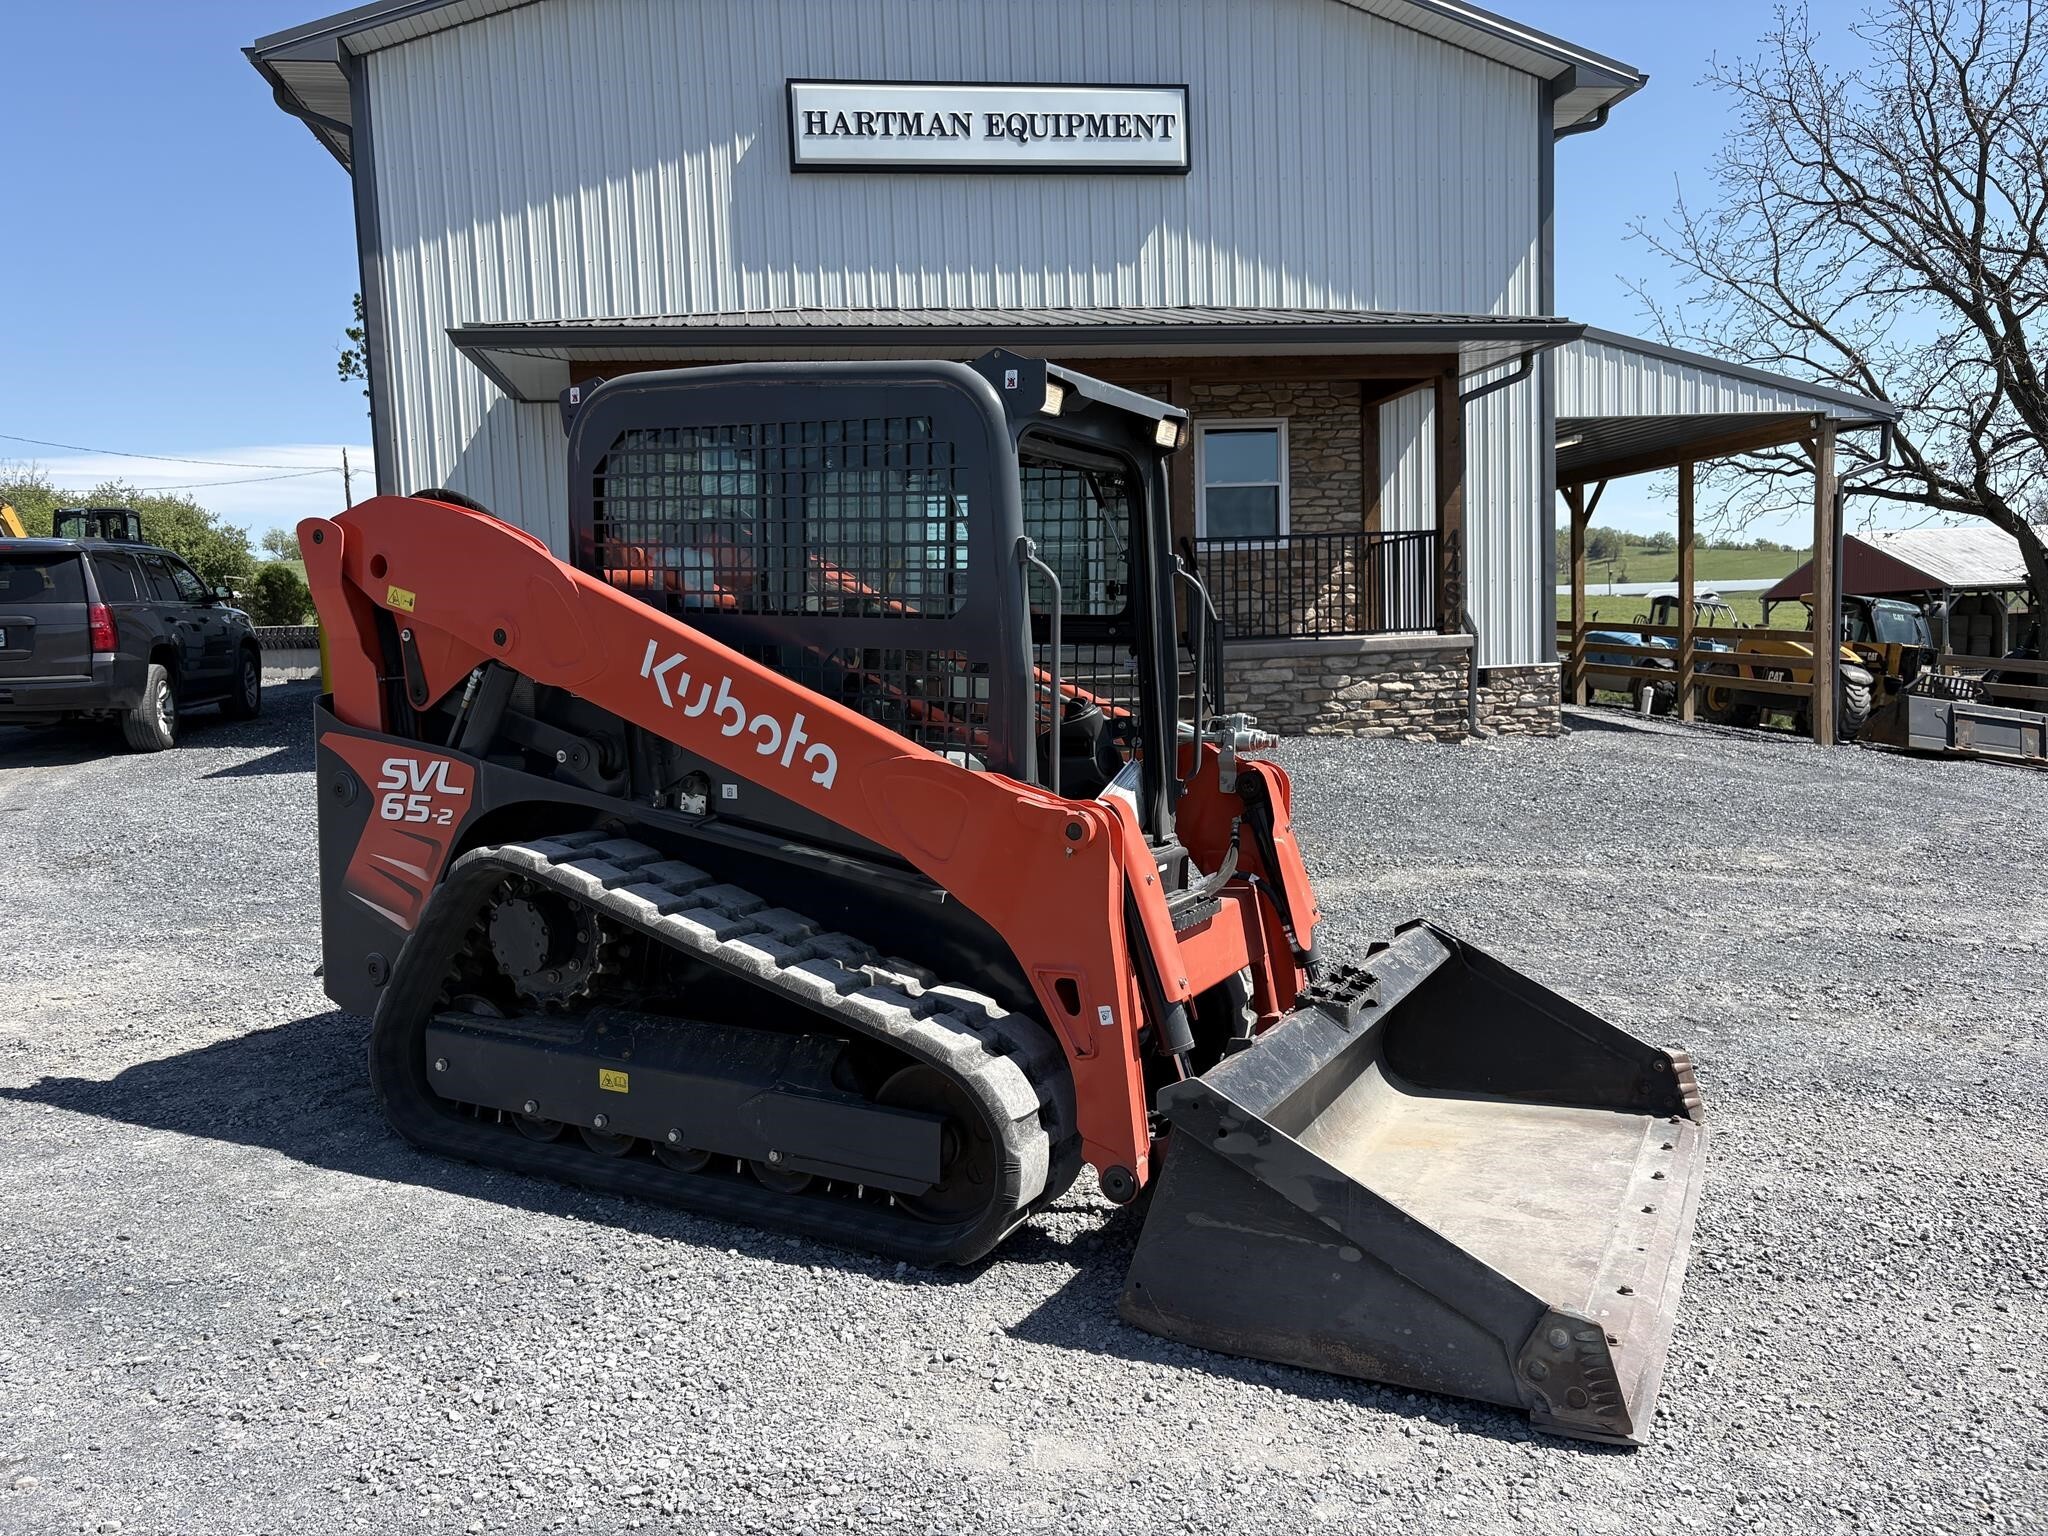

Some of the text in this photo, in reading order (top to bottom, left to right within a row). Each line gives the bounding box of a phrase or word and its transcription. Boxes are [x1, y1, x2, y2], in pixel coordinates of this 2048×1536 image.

[804, 110, 1176, 143] HARTMAN EQUIPMENT
[1767, 670, 1785, 682] CAT
[640, 638, 838, 790] Kubota
[377, 758, 465, 795] SVL
[380, 792, 454, 825] 65-2
